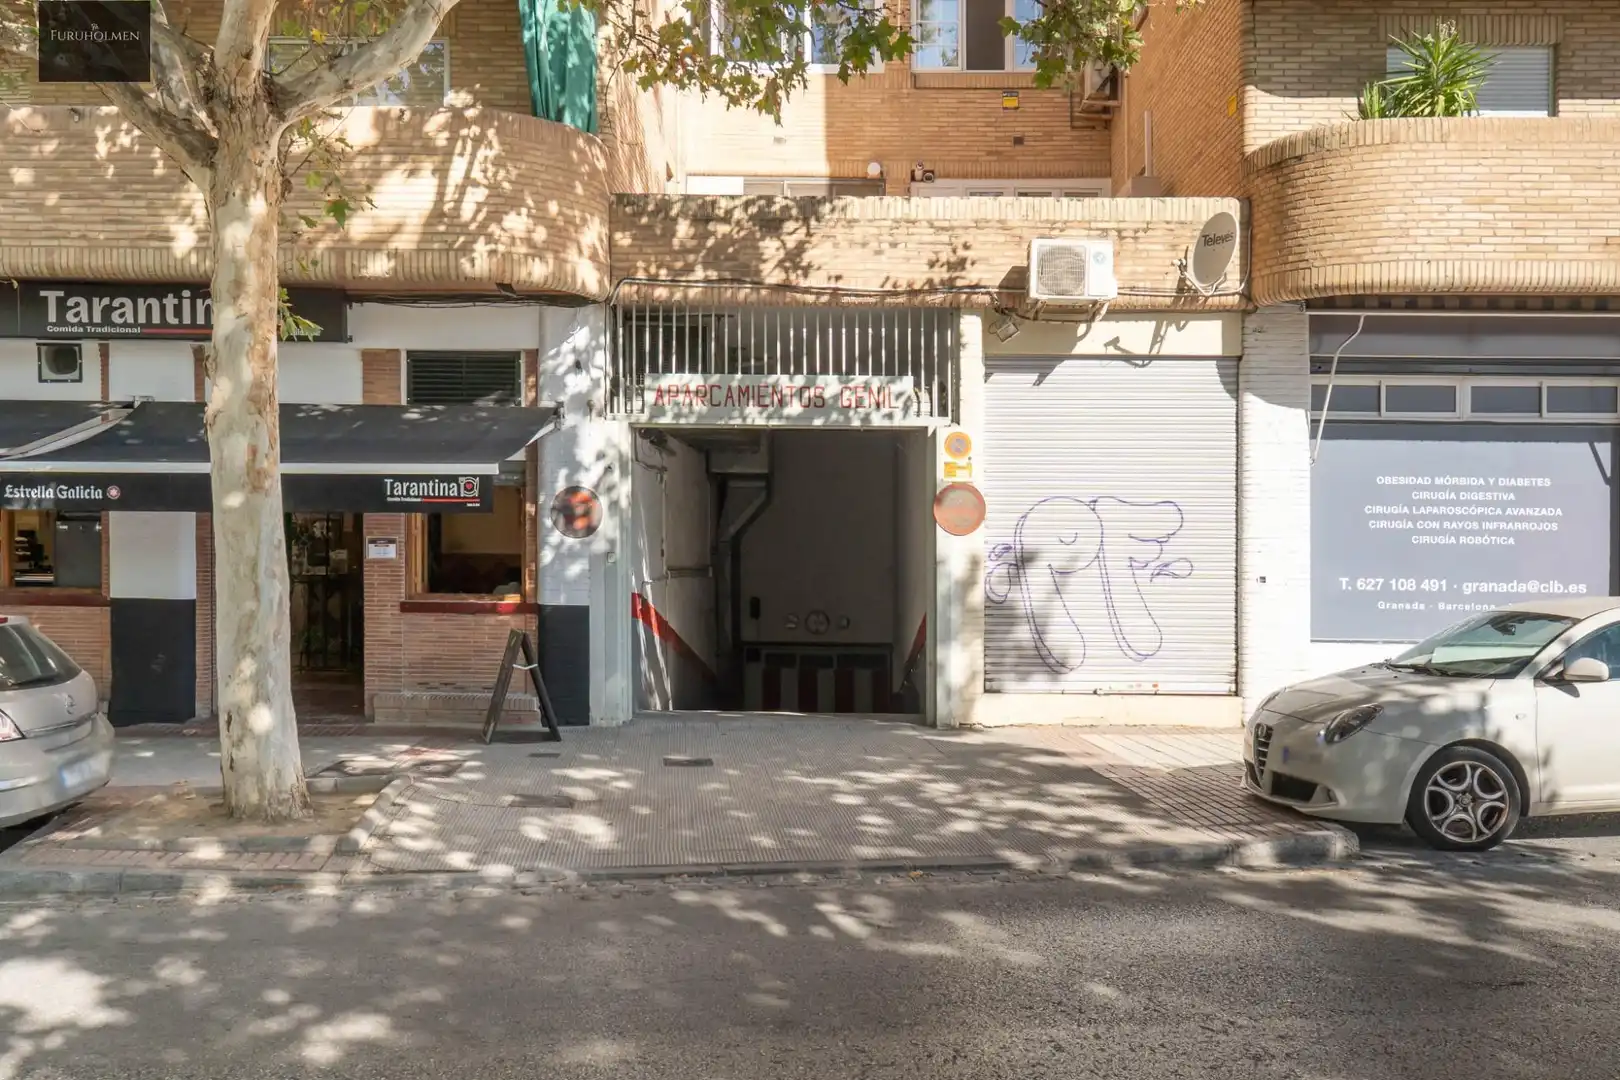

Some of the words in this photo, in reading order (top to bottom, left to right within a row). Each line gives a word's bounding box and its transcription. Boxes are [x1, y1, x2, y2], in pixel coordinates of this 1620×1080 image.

[39, 290, 213, 325] Tarantin
[46, 325, 84, 333] Comida
[85, 325, 141, 333] Tradicional
[653, 384, 826, 408] APARCAMIENTOS
[840, 385, 899, 409] GENIL
[1376, 476, 1431, 485] OBESIDAD
[1435, 475, 1485, 485] MÓRBIDA
[1488, 477, 1495, 485] Y
[1498, 477, 1551, 487] DIABETES
[4, 484, 55, 499] Estrella
[56, 485, 103, 499] Galicia
[384, 479, 458, 496] Tarantina
[1412, 489, 1456, 500] CIRUGÍA
[1460, 492, 1515, 501] DIGESTIVA
[1364, 504, 1409, 514] CIRUGÍA
[1413, 505, 1502, 516] LAPAROSCÓPICA
[1505, 507, 1563, 516] AVANZADA
[1368, 519, 1414, 529] CIRUGÍA
[1417, 521, 1439, 529] CON
[1443, 521, 1479, 530] RAYOS
[1482, 521, 1558, 531] INFRARROJOS
[1411, 533, 1456, 544] CIRUGÍA
[1460, 534, 1515, 545] ROBÓTICA
[1339, 577, 1352, 590] T.
[1357, 578, 1384, 590] 627
[1389, 578, 1416, 591] 108
[1420, 579, 1447, 591] 491
[1378, 601, 1425, 610] Granada
